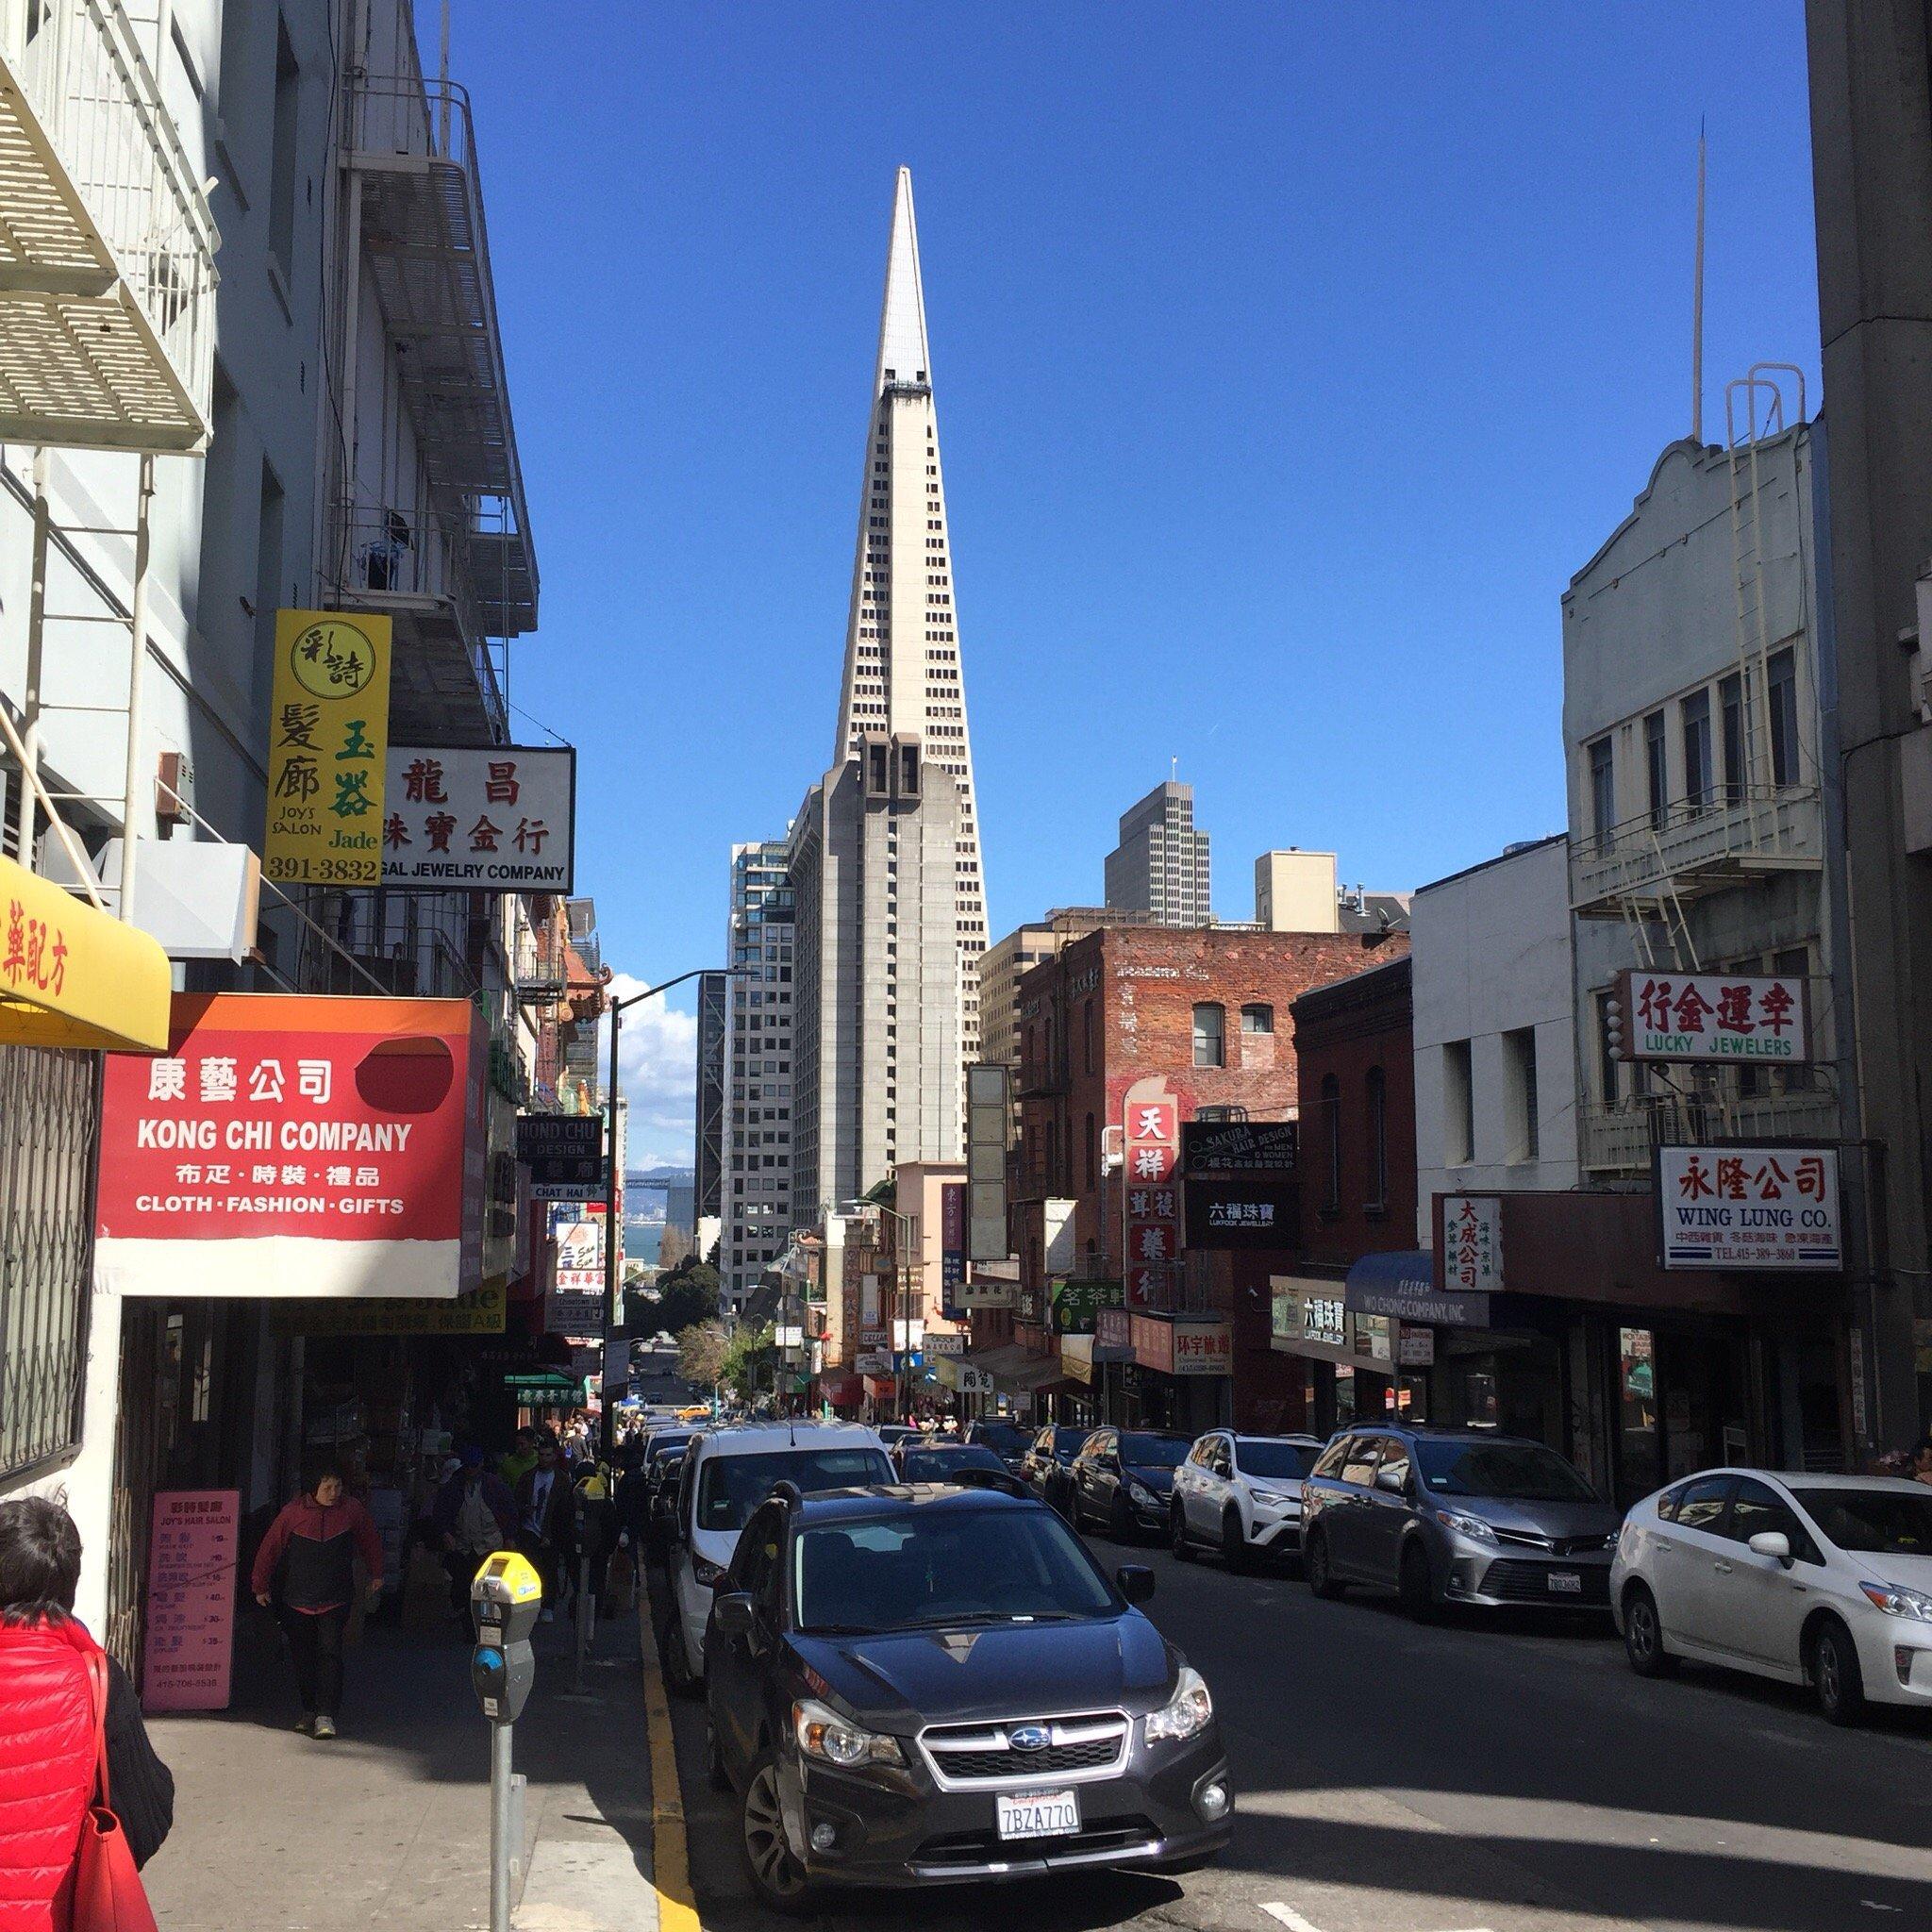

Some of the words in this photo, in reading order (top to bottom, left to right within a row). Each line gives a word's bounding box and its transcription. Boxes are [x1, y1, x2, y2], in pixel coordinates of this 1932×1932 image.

[275, 703, 324, 804] 髮廊
[280, 806, 315, 822] JOY'S
[272, 821, 323, 836] SALON
[328, 829, 377, 849] Jade
[269, 856, 377, 882] 391-3832
[411, 862, 485, 880] JEWELRY
[488, 864, 565, 882] COMPANY
[1645, 1035, 1693, 1052] LUCKY
[1709, 1036, 1791, 1056] JEWELERS
[148, 1057, 332, 1105] 康藝公司
[137, 1120, 216, 1150] KONG
[225, 1120, 272, 1151] CHI
[280, 1121, 412, 1152] COMPANY
[1206, 1125, 1252, 1148] SAKURA
[1231, 1138, 1257, 1154] HAIR
[1257, 1125, 1292, 1145] DESIGN
[1679, 1156, 1826, 1203] 永隆公司
[536, 1187, 561, 1197] CHAT
[567, 1188, 584, 1197] HAI
[1209, 1203, 1274, 1220] 六福珠寶
[1676, 1208, 1733, 1226] WING
[1740, 1208, 1794, 1227] LUNG
[1801, 1209, 1832, 1228] CO.
[1457, 1200, 1479, 1288] 大成公司
[1378, 1296, 1407, 1317] CHONG
[184, 1516, 203, 1525] HAIR
[206, 1515, 231, 1524] SALON
[1003, 1805, 1074, 1832] 7BZA770
